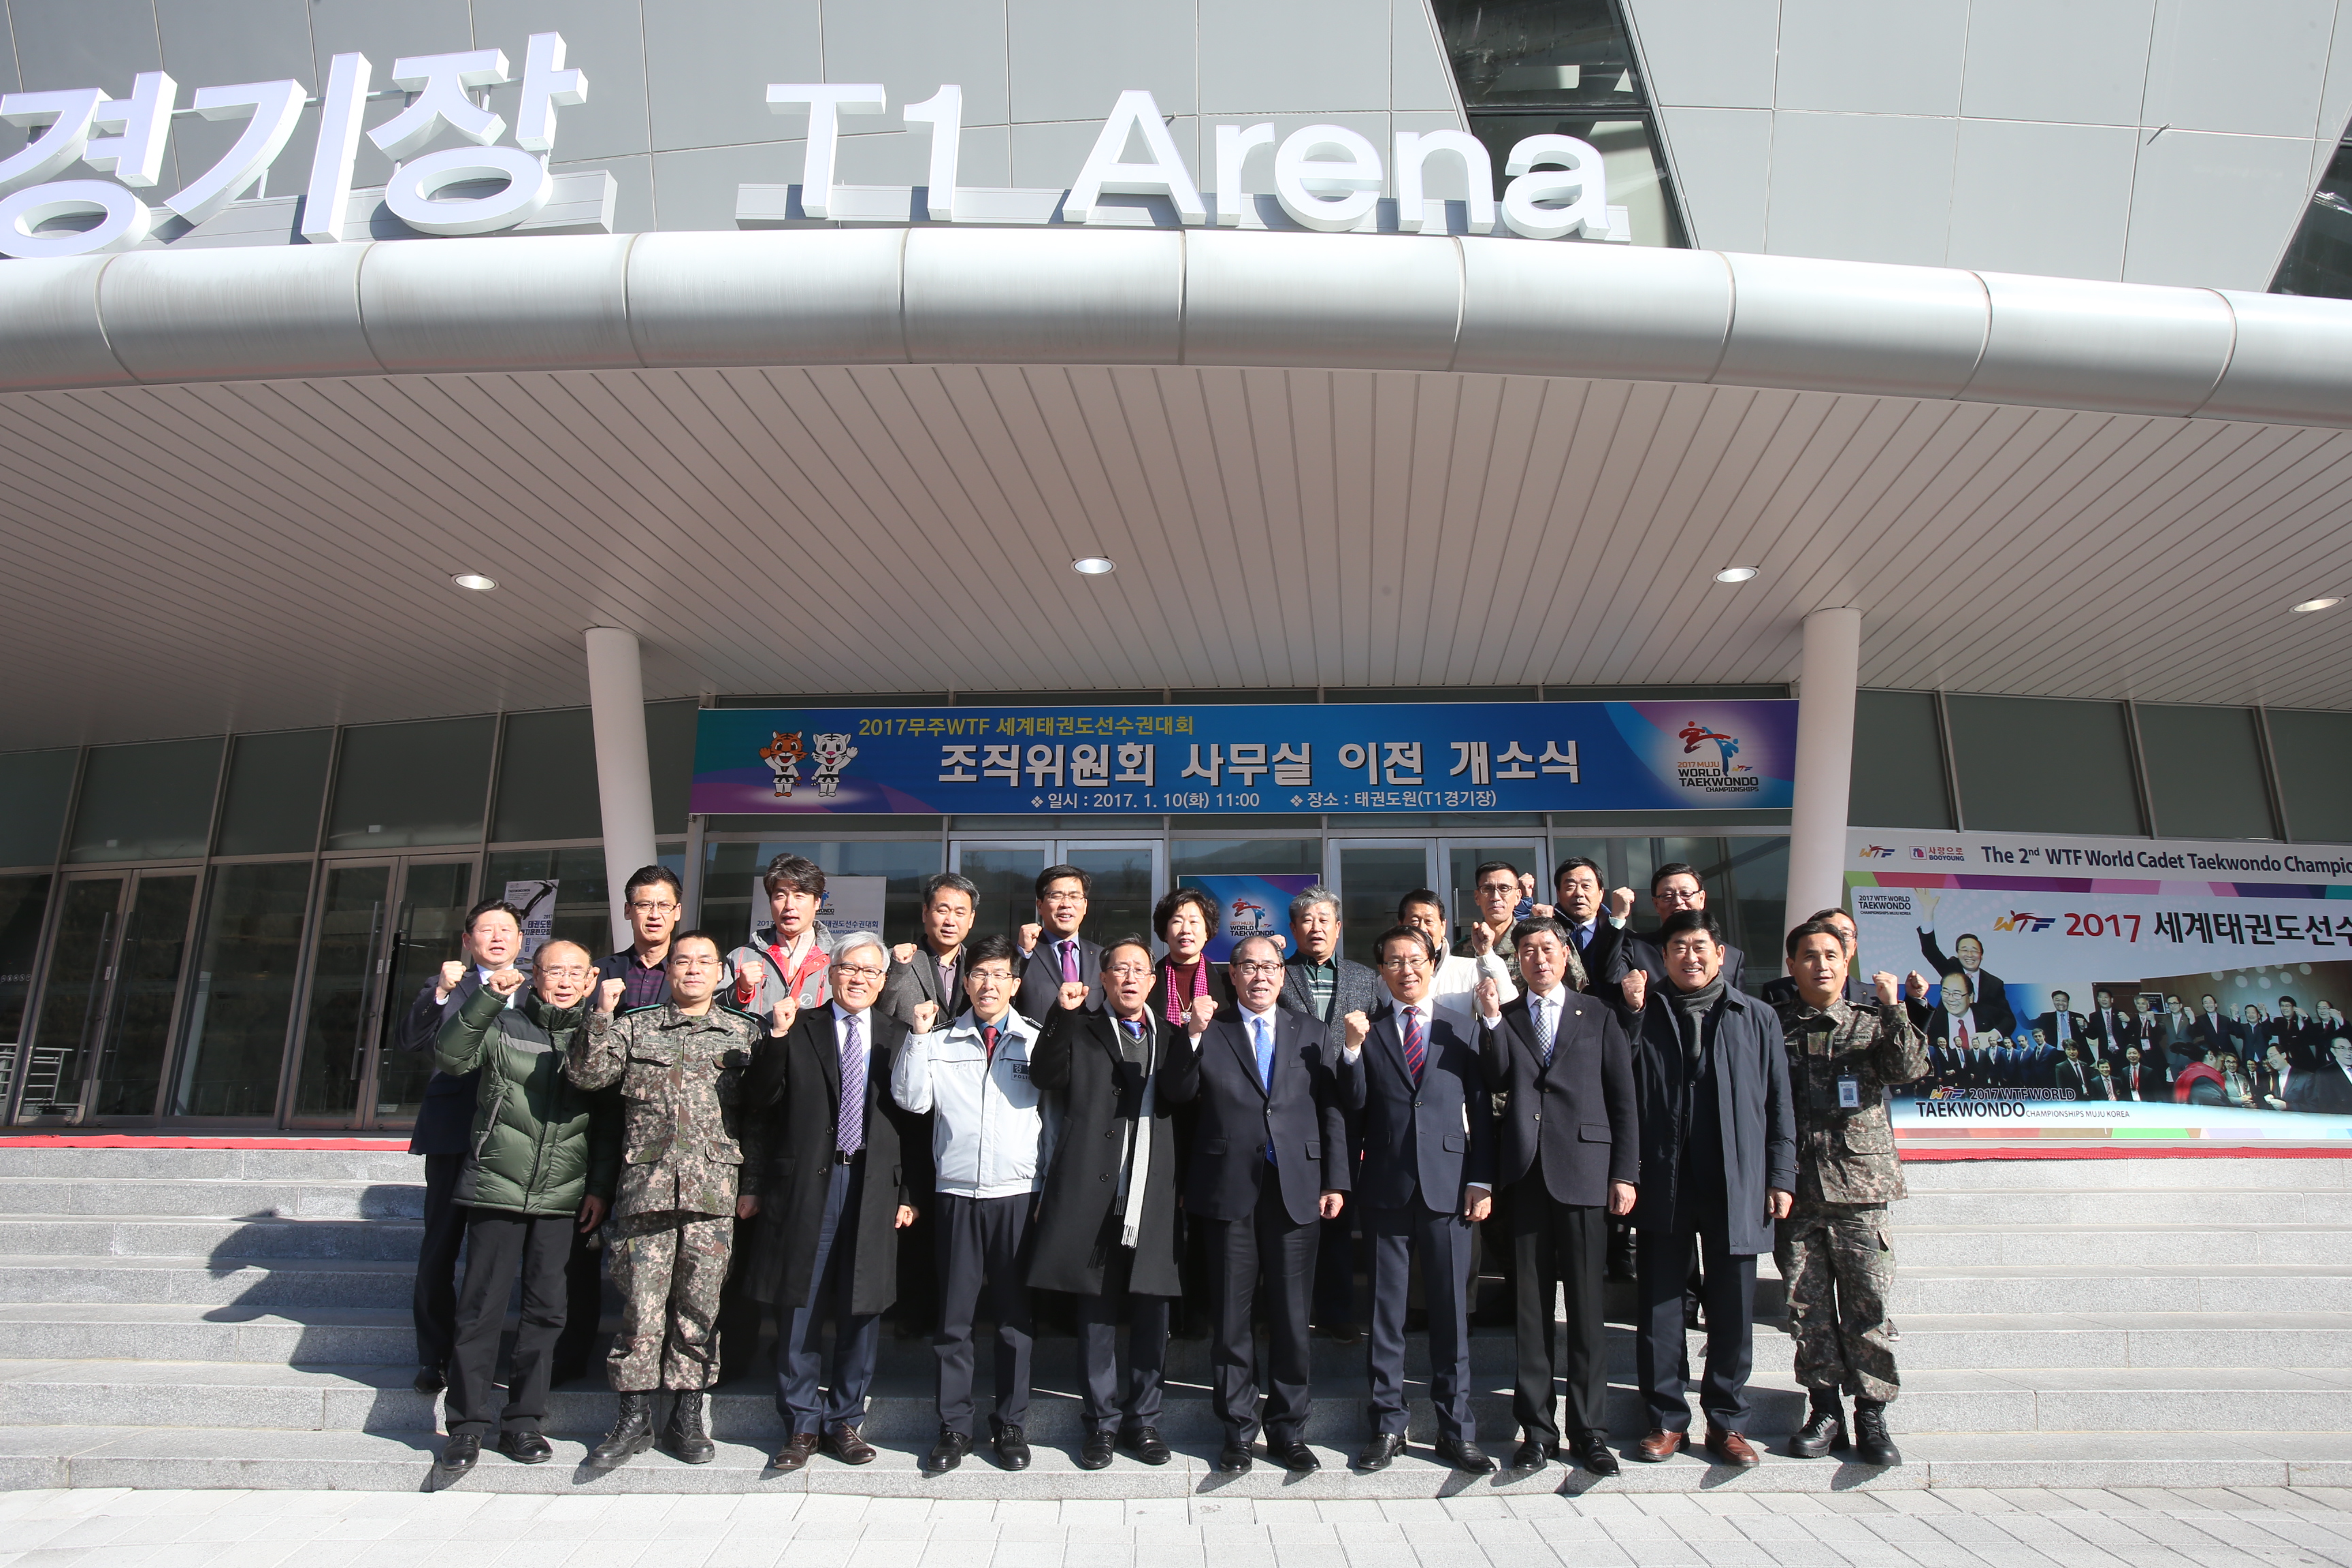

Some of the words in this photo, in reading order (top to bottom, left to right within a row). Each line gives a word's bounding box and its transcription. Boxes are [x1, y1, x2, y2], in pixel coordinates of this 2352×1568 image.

[0, 31, 588, 259] 경기장
[766, 83, 962, 220] T1
[1062, 89, 1611, 241] Arena
[858, 718, 990, 737] 2017무주WTF
[996, 715, 1194, 736] 세계태권도선수권대회
[938, 742, 1156, 787] 조직위원회
[1181, 742, 1313, 787] 사무실
[1338, 742, 1424, 785] 이전
[1450, 740, 1580, 785] 개소식
[1678, 768, 1721, 777] WORLD
[1678, 777, 1759, 787] TAEKWONDO
[1048, 793, 1078, 808] 일시
[1093, 793, 1138, 808] 2017.
[1144, 793, 1157, 808] 1.
[1164, 791, 1210, 809] 10(화)
[1216, 792, 1260, 808] 11:00
[1307, 791, 1339, 808] 장소
[1354, 790, 1497, 808] 태권도원(T1경기장)
[1928, 847, 1964, 855] 사랑으로
[1981, 845, 2014, 864] The
[2019, 847, 2040, 864] 2nd
[2045, 848, 2082, 866] WTF
[2084, 849, 2135, 868] World
[2137, 851, 2185, 870] Cadet
[2187, 853, 2282, 872] Taekwondo
[1858, 902, 1911, 911] TAEKWONDO
[527, 920, 552, 928] 태권도원
[2063, 913, 2141, 943] 2017
[1969, 1088, 1999, 1101] 2017
[1999, 1088, 2029, 1101] WTF
[2029, 1088, 2076, 1101] WORLD
[1915, 1101, 2025, 1118] TAEKWONDO
[2025, 1110, 2084, 1118] CHAMPIONSHIPS
[2106, 1110, 2130, 1118] KOREA
